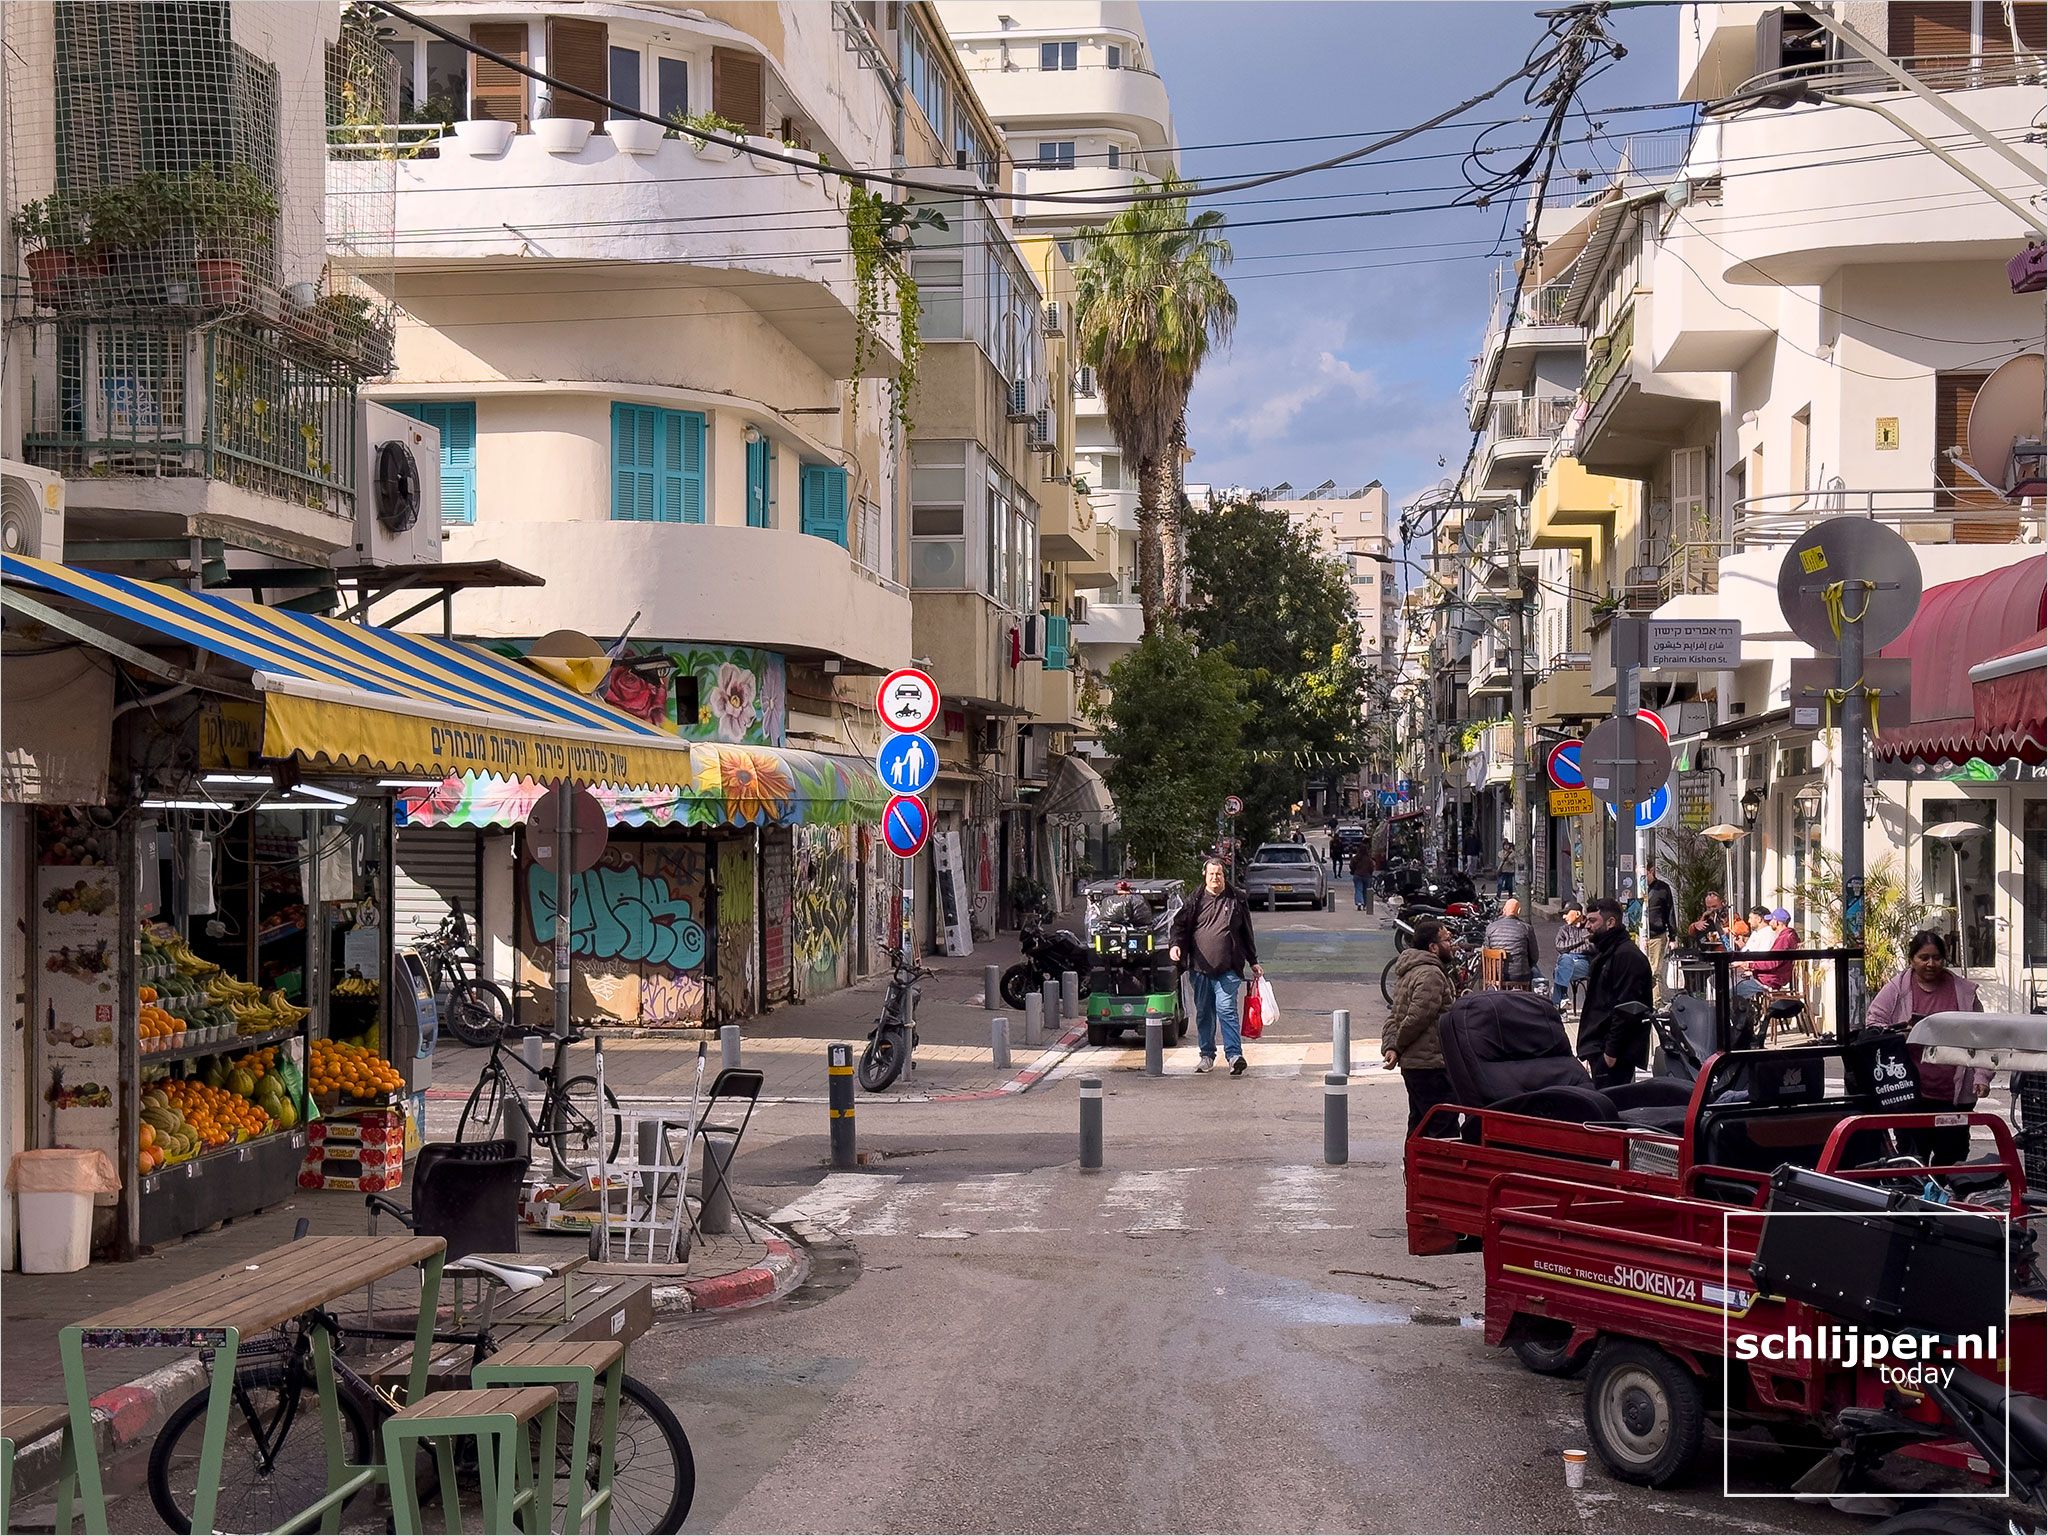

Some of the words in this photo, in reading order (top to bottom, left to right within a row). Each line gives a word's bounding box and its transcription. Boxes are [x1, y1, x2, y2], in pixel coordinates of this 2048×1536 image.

[1654, 627, 1682, 637] קישון
[1684, 627, 1717, 635] אפרים
[1653, 640, 1682, 651] كيشون
[1683, 641, 1707, 651] إفرايم
[1708, 641, 1724, 651] شارع
[1653, 655, 1687, 665] Ephraim
[1689, 655, 1717, 663] Kishon
[431, 726, 487, 762] מובחרים
[490, 735, 527, 773] וירקות
[534, 742, 565, 769] פירות
[568, 742, 608, 778] פלורנטין
[610, 752, 627, 778] שוק
[1533, 1259, 1572, 1275] ELECTRIC
[1574, 1267, 1614, 1284] TRICYCLE
